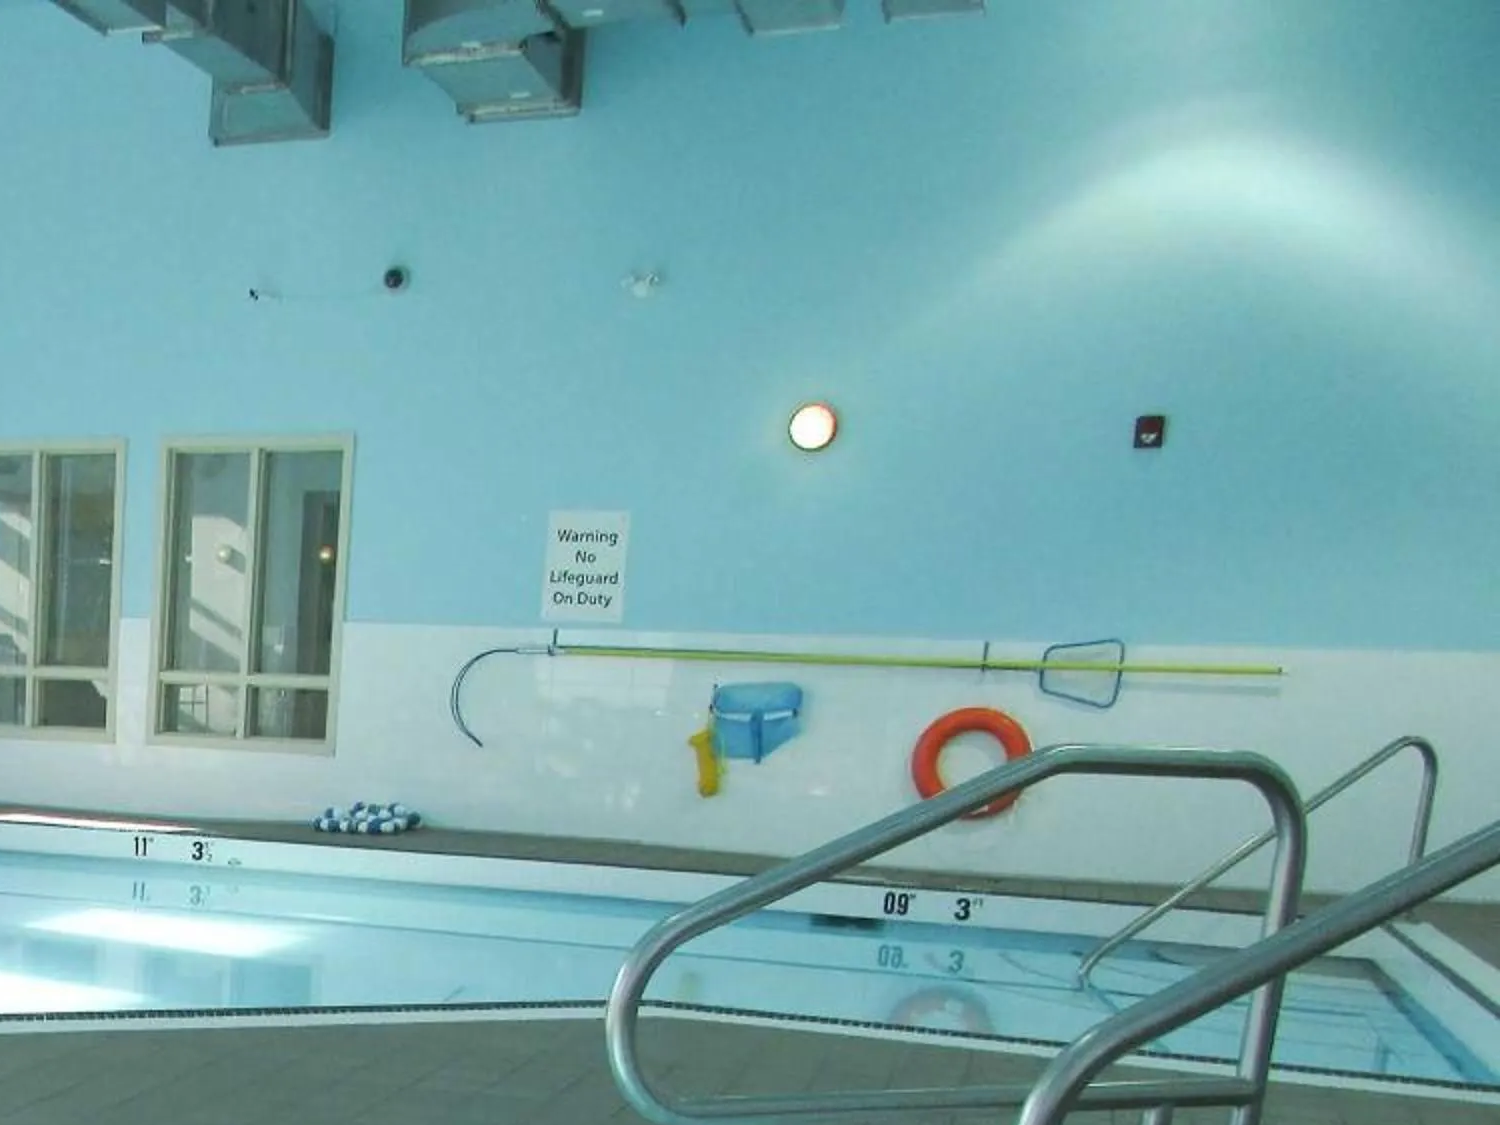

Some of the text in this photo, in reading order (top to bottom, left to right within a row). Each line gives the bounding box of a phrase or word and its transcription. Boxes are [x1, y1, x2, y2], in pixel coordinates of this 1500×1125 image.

[557, 528, 619, 547] Warning
[575, 550, 597, 564] No
[549, 569, 619, 587] Lifeguard
[553, 591, 613, 608] On Duty
